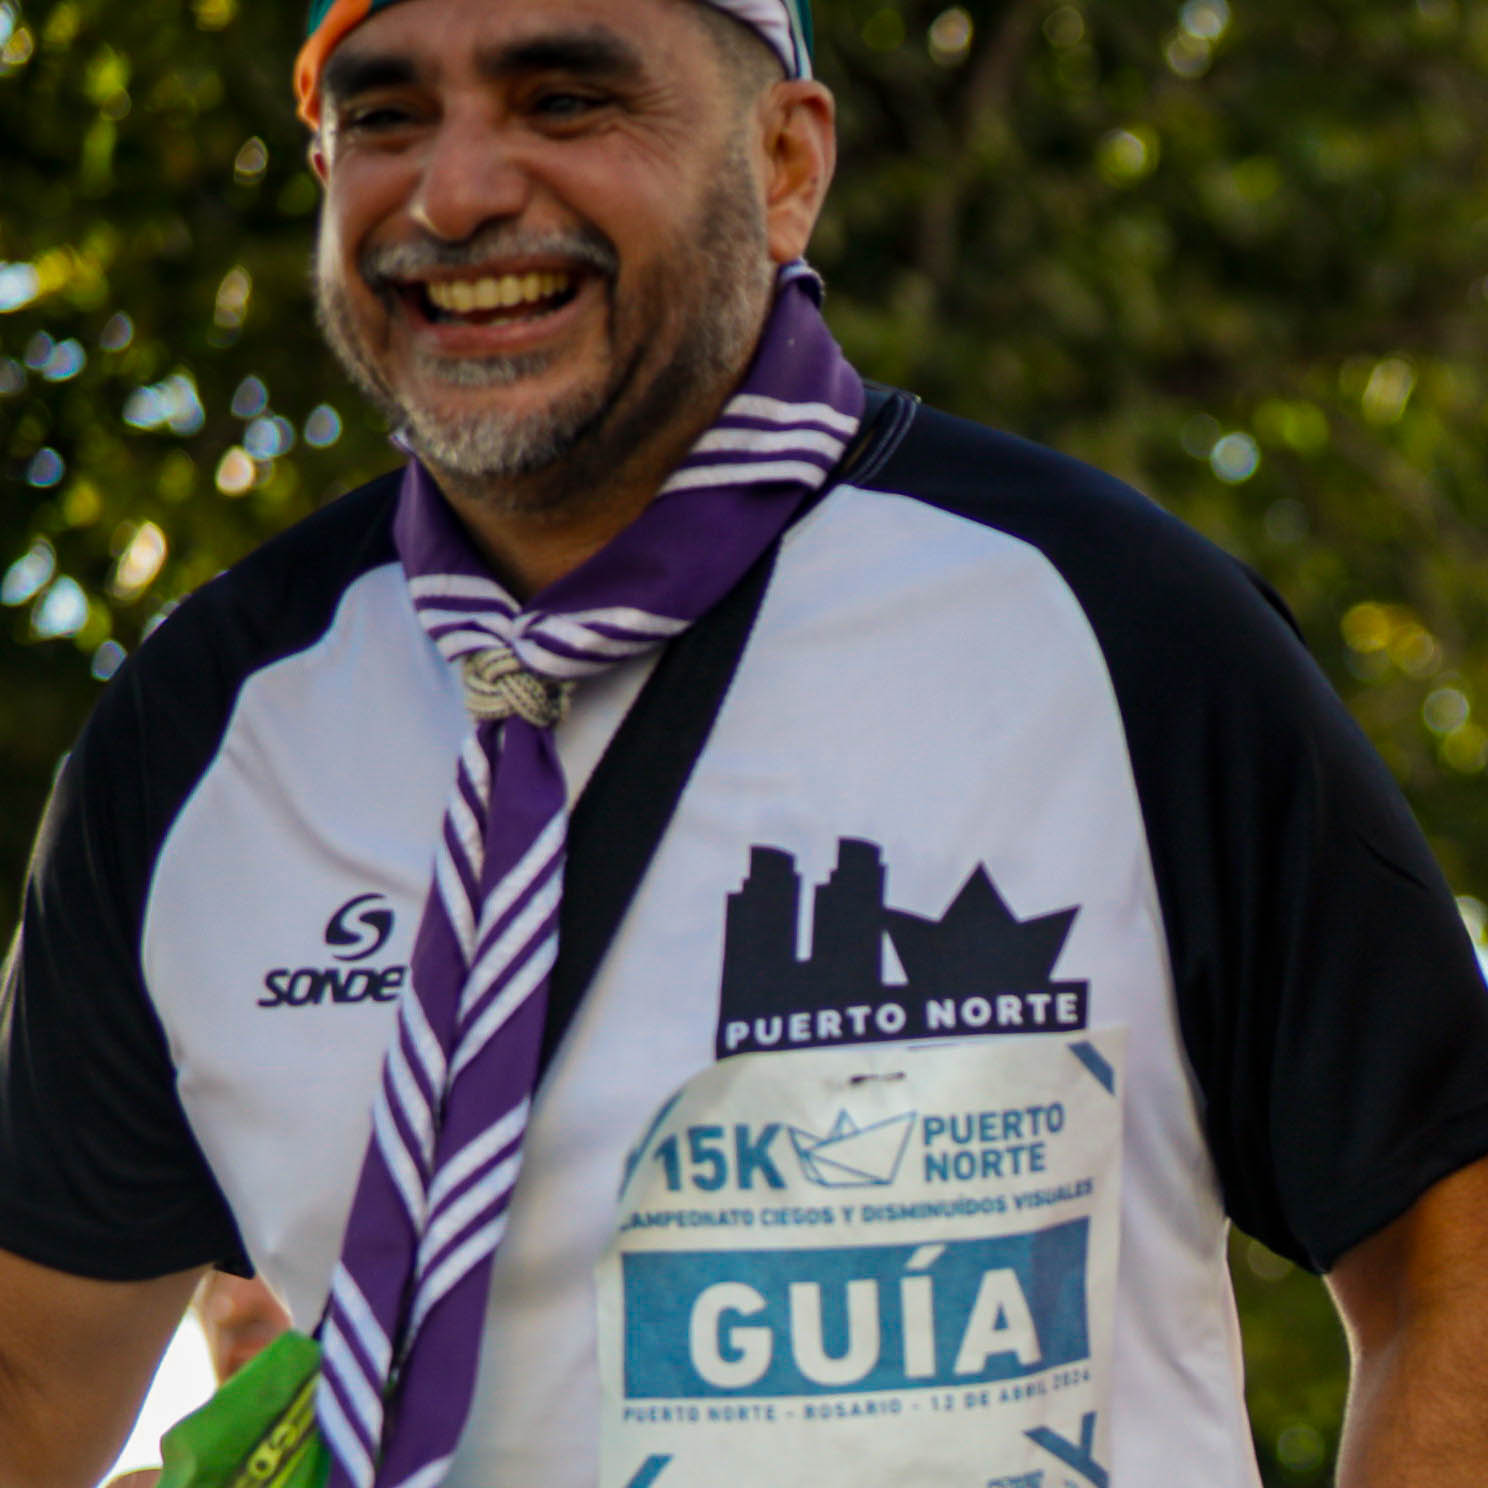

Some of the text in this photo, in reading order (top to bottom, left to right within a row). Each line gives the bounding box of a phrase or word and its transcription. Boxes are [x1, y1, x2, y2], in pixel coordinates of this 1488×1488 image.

[725, 992, 1079, 1050] PUERTO NORTE
[923, 1101, 1065, 1147] PUERTO
[652, 1122, 788, 1193] 15K
[924, 1141, 1048, 1184] NORTE
[688, 1246, 1043, 1391] GUÍA
